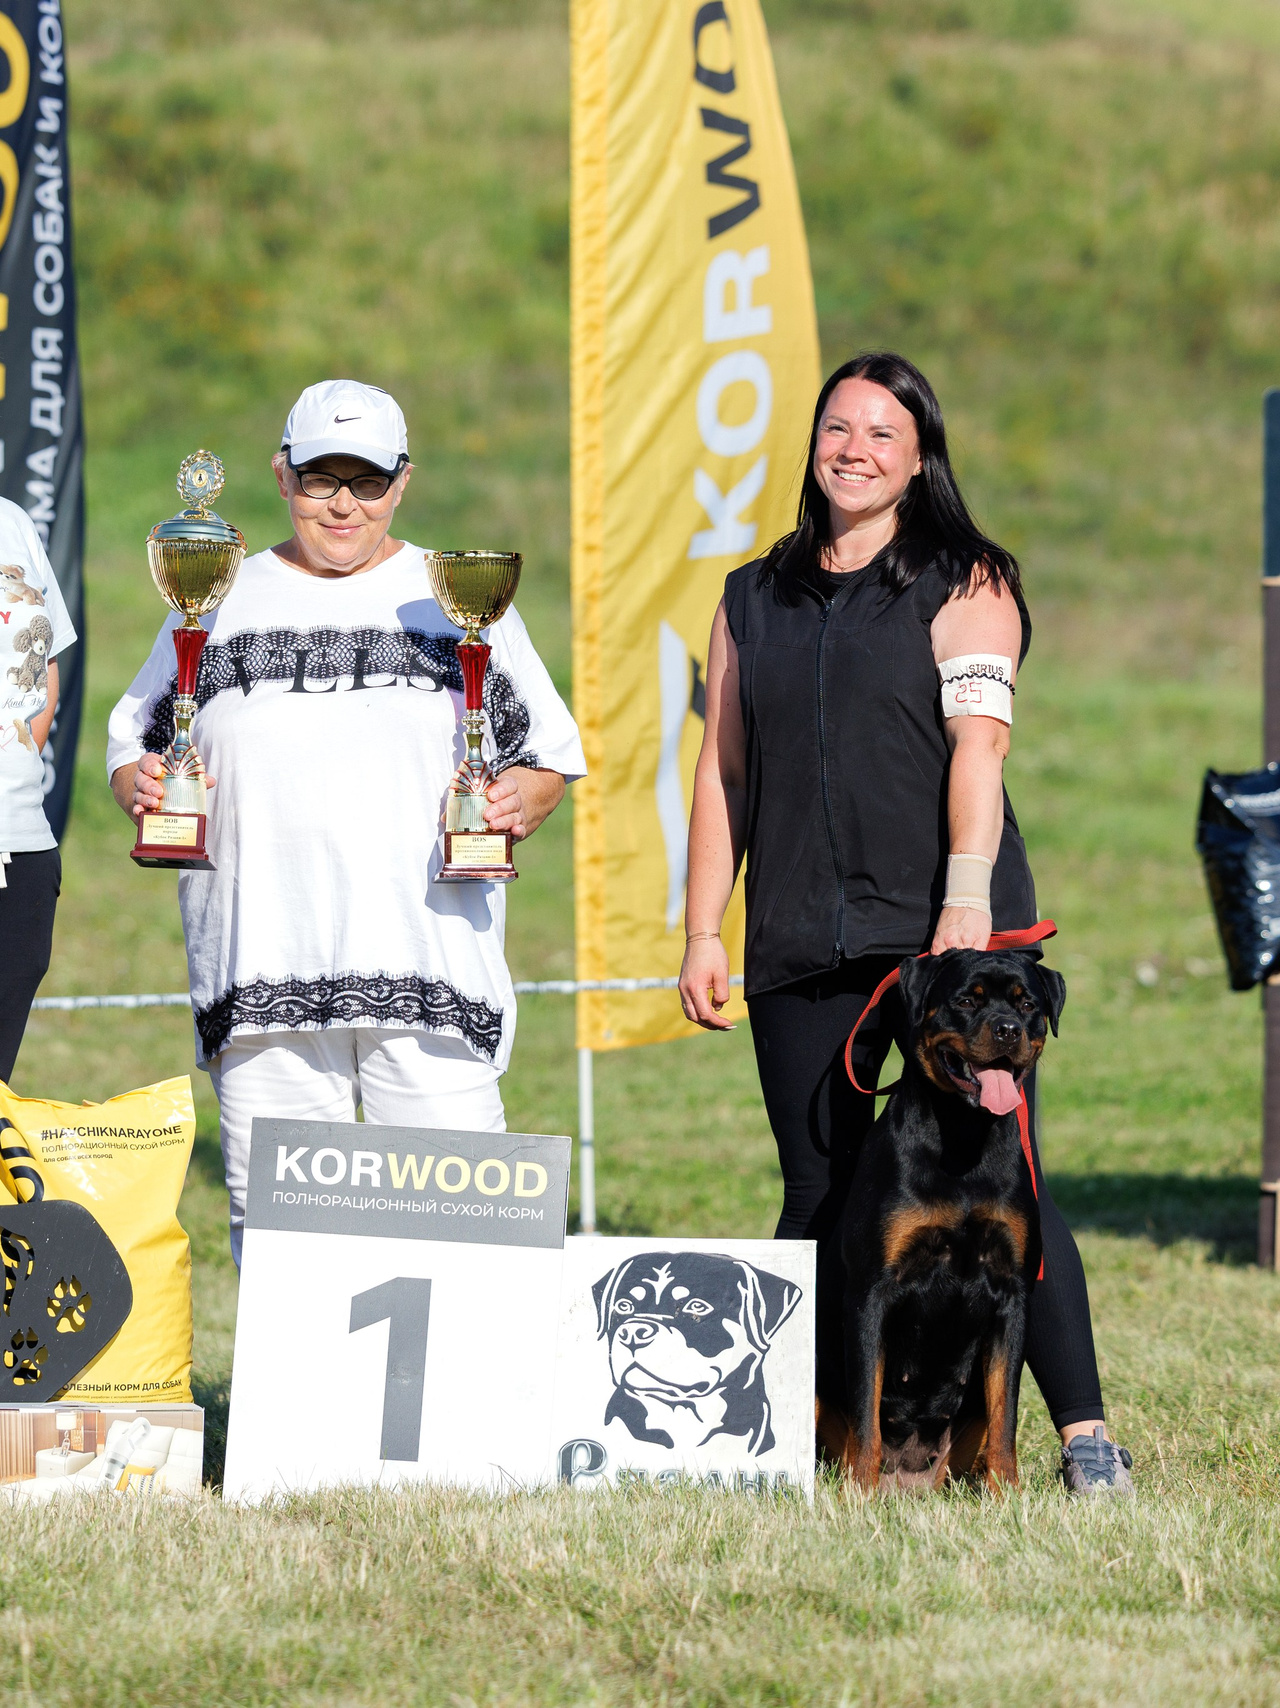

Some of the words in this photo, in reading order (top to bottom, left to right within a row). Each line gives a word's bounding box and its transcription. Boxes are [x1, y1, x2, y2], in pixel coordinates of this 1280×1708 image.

[35, 95, 63, 133] И
[33, 143, 64, 316] СОБАК
[30, 326, 65, 437] ДЛЯ
[968, 664, 1004, 676] SIRIUS
[955, 682, 982, 703] 25
[41, 1125, 182, 1141] #HAVCHIKNARAYONE
[42, 1142, 128, 1153] ПОЛНОРАЦИОННЫЙ
[130, 1142, 158, 1150] СУХОЙ
[160, 1138, 185, 1148] КОРМ
[275, 1145, 548, 1198] KORWOOD
[272, 1191, 437, 1214] ПОЛНОРАЦИОННЫЙ
[440, 1202, 494, 1218] СУХОЙ
[498, 1206, 544, 1221] КОРМ
[348, 1276, 432, 1462] 1
[62, 1382, 111, 1392] ОЛЕЗНЫЙ
[142, 1382, 160, 1392] ДЛЯ
[162, 1379, 183, 1389] СОБАК
